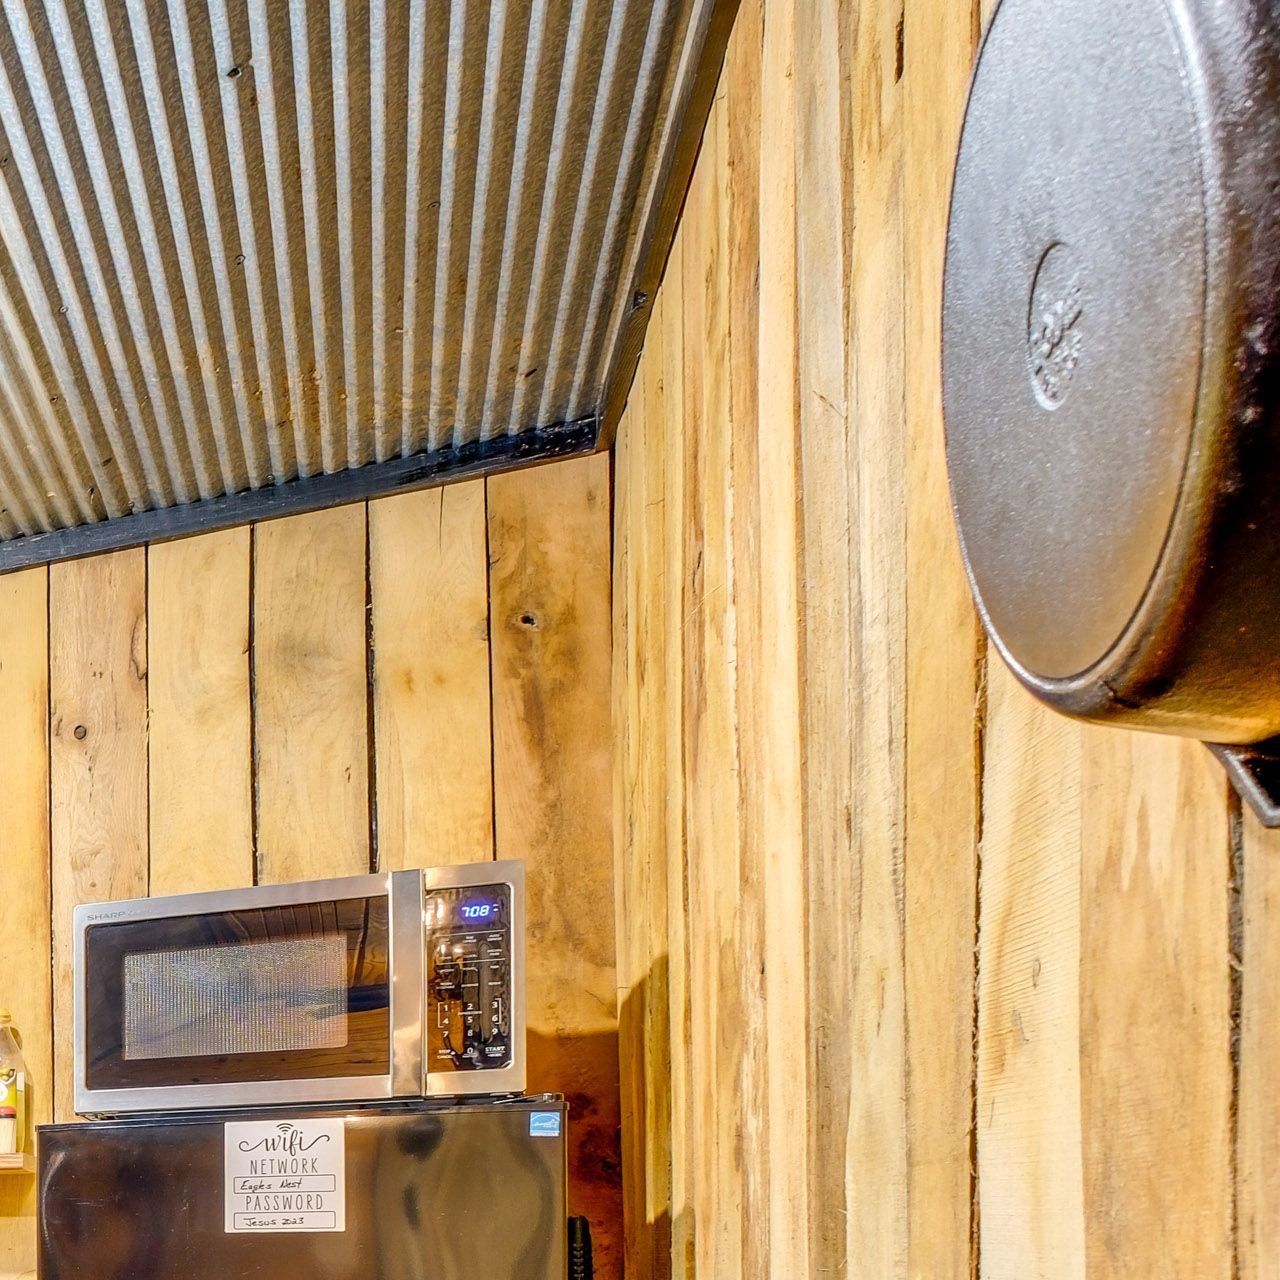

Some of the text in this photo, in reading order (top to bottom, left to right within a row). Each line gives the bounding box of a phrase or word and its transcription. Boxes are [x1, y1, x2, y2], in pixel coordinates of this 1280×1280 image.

[86, 911, 126, 921] SHARP
[443, 1004, 449, 1012] 1
[491, 1001, 498, 1009] 3
[442, 1017, 449, 1025] 4
[467, 1016, 473, 1024] 5
[491, 1014, 498, 1022] 6
[442, 1030, 449, 1038] 7
[467, 1029, 473, 1037] 8
[491, 1027, 499, 1035] 9
[239, 1130, 330, 1156] wifi
[250, 1158, 319, 1175] NETWORK
[245, 1194, 324, 1211] PASSWORD
